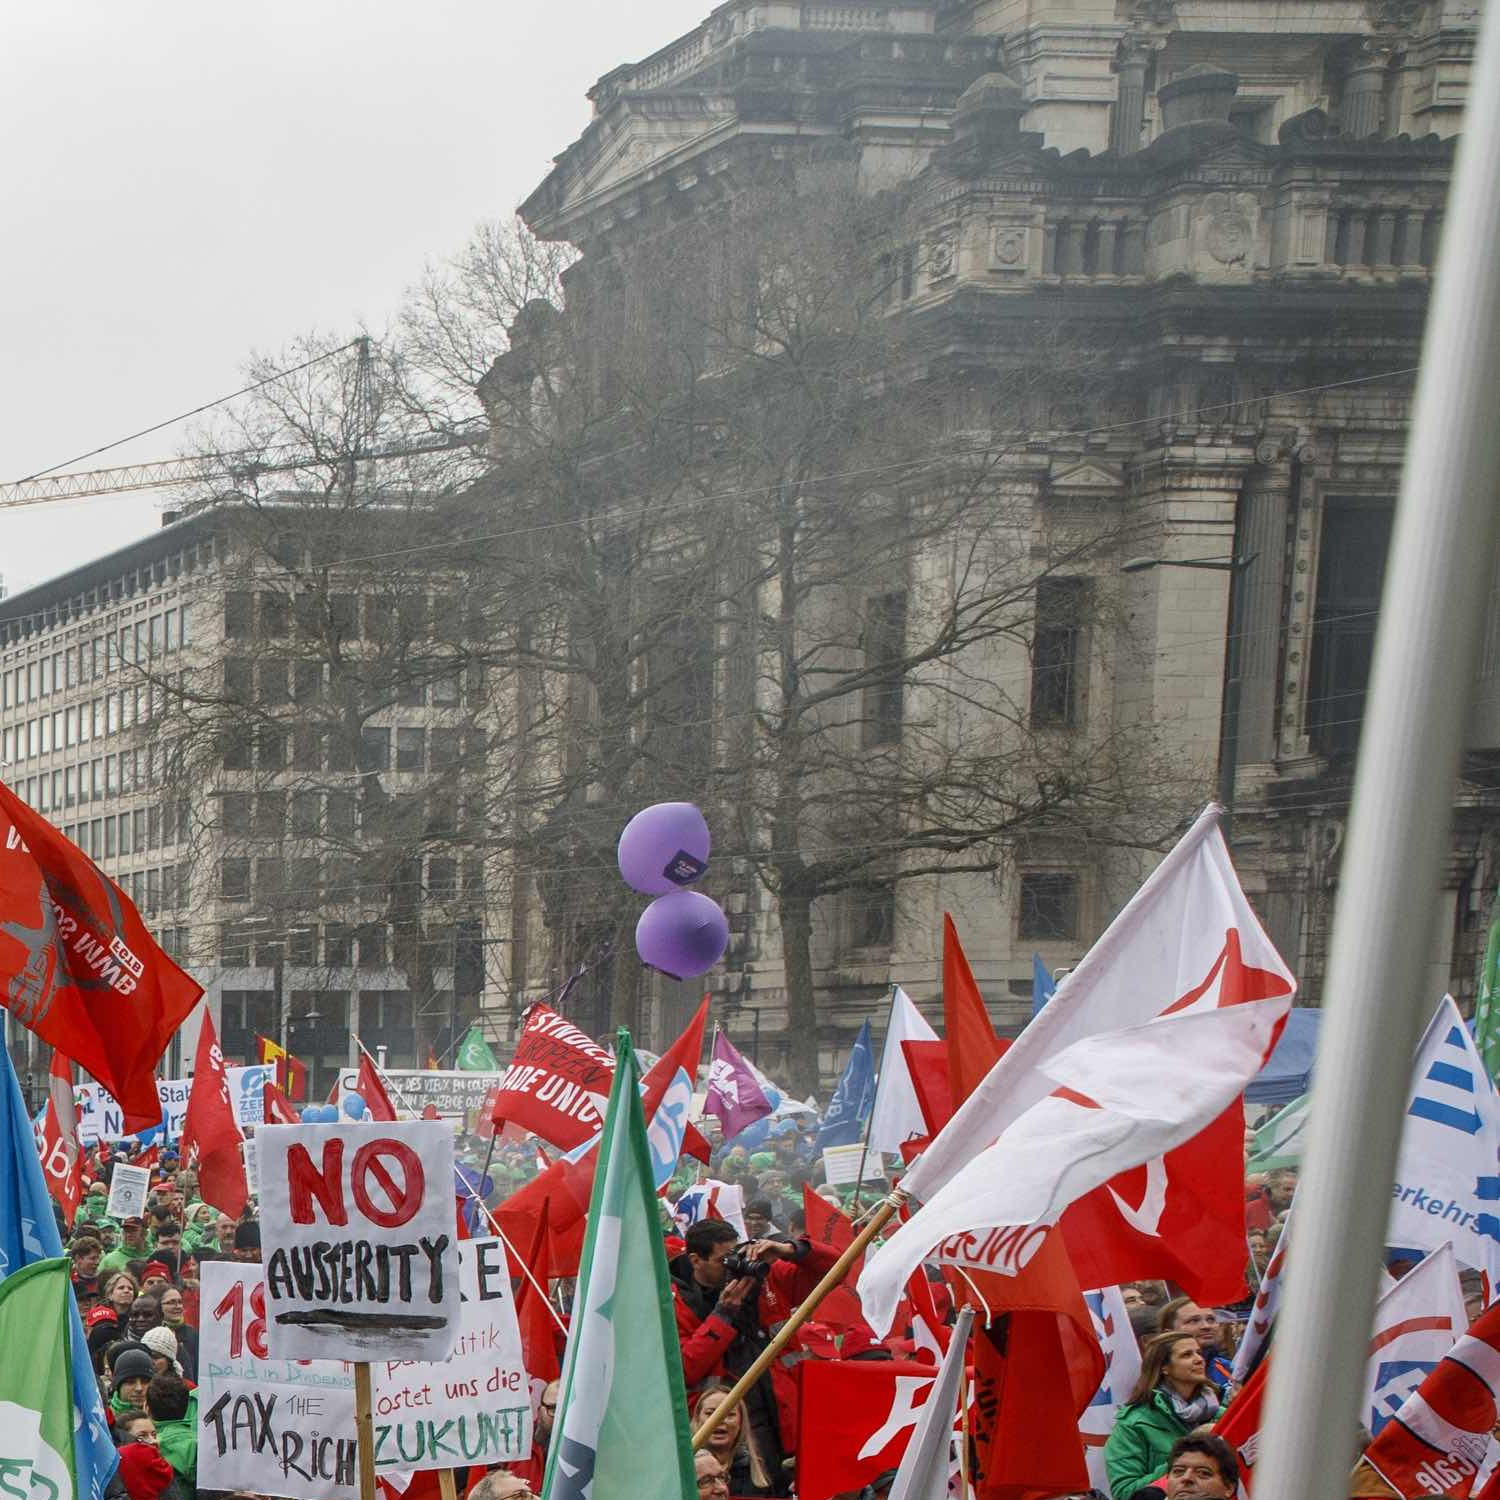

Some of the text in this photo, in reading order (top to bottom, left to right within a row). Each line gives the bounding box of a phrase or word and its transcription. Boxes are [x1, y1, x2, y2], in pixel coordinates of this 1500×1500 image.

[529, 1011, 616, 1074] SYNDICA
[286, 1137, 425, 1228] NO
[267, 1234, 449, 1303] AUSTERITY
[208, 1362, 258, 1393] paid
[444, 1378, 479, 1400] uns
[487, 1367, 522, 1394] die
[203, 1390, 326, 1458] TAX THE
[374, 1405, 531, 1467] ZUKUNFT
